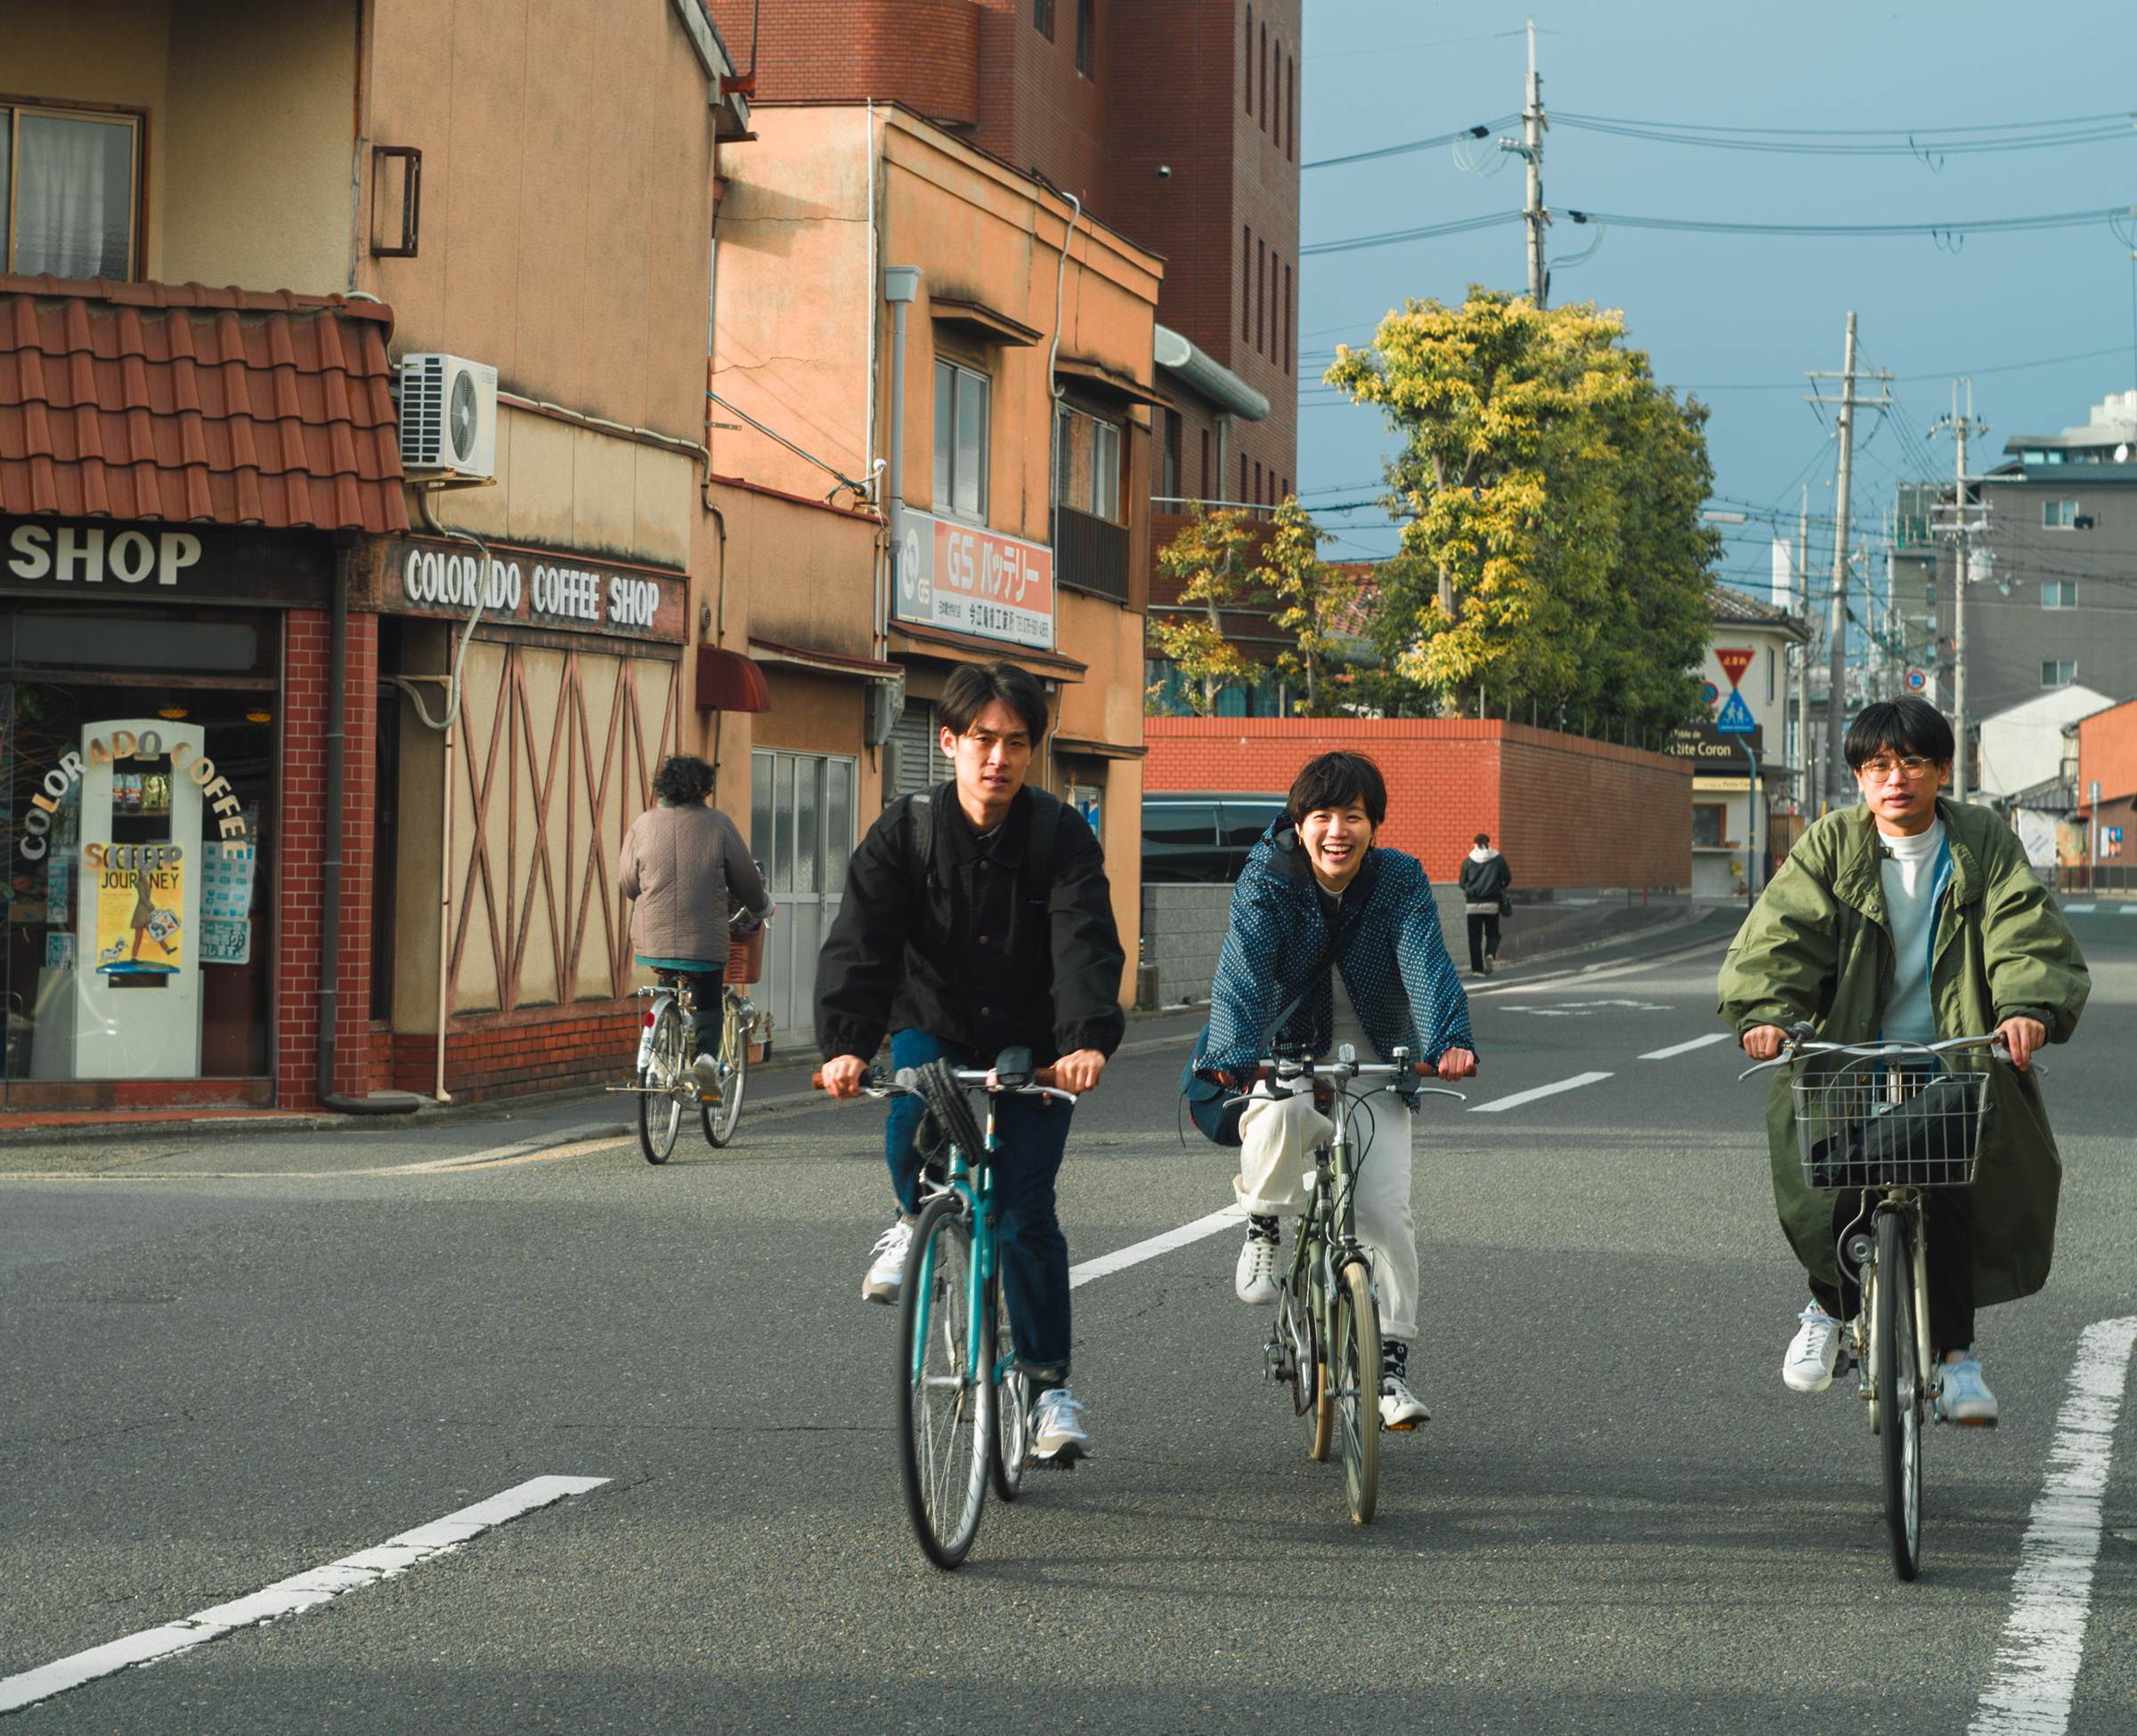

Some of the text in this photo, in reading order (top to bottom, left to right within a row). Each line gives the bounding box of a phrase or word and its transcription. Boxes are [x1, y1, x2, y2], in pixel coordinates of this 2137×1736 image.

[7, 523, 202, 586] SHOP
[947, 531, 1039, 602] GS バッテリー
[403, 548, 660, 627] COLORADO COFFEE SHOP
[918, 579, 930, 604] GS
[1723, 654, 1747, 666] 止まれ
[1693, 729, 1701, 739] de
[1698, 741, 1731, 757] Coron
[20, 729, 247, 861] COLORADO COFFEE
[84, 842, 183, 872] SHOP
[101, 872, 179, 889] JOURNEY
